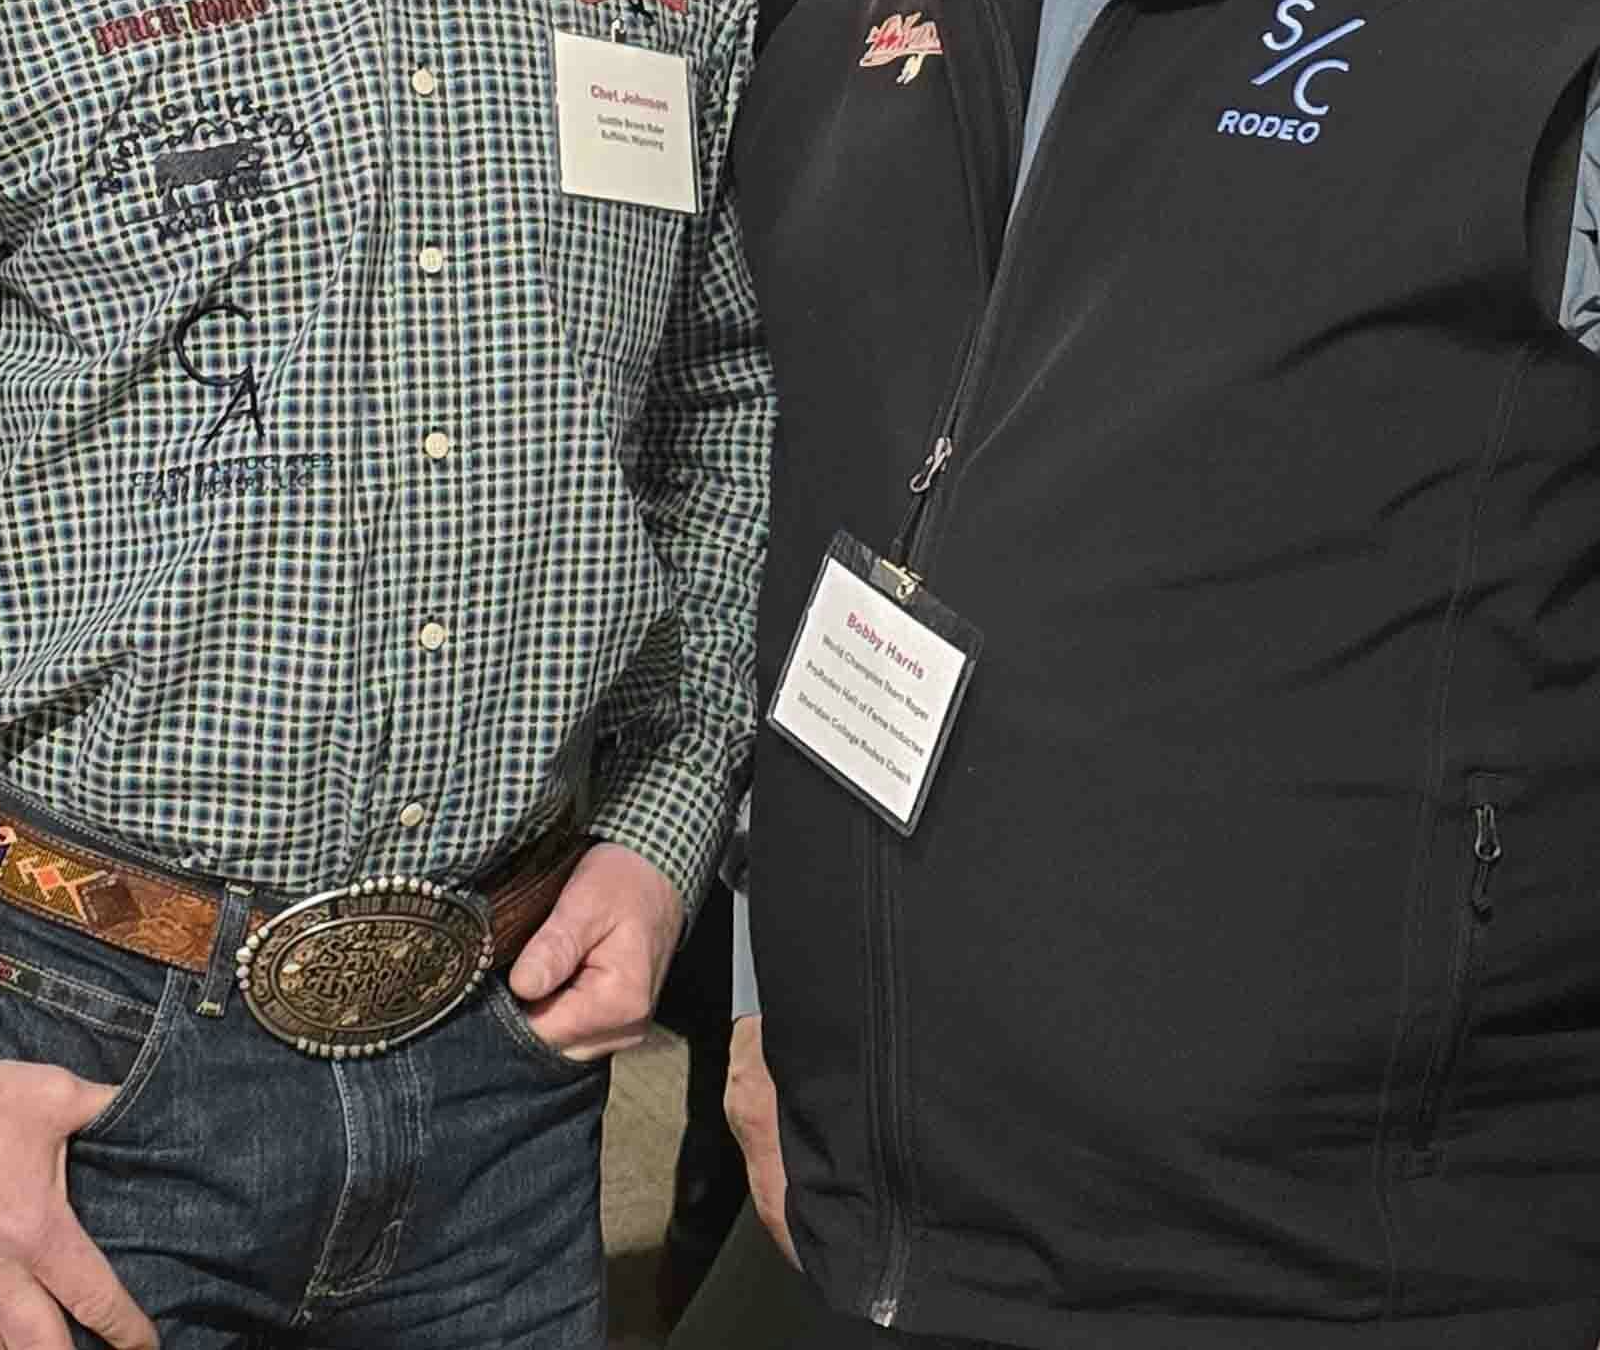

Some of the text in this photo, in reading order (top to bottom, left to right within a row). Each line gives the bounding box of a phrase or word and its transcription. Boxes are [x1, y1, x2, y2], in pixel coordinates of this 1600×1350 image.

[591, 85, 619, 103] Chet
[1217, 110, 1321, 144] RODEO
[846, 612, 924, 679] Bobby Harris
